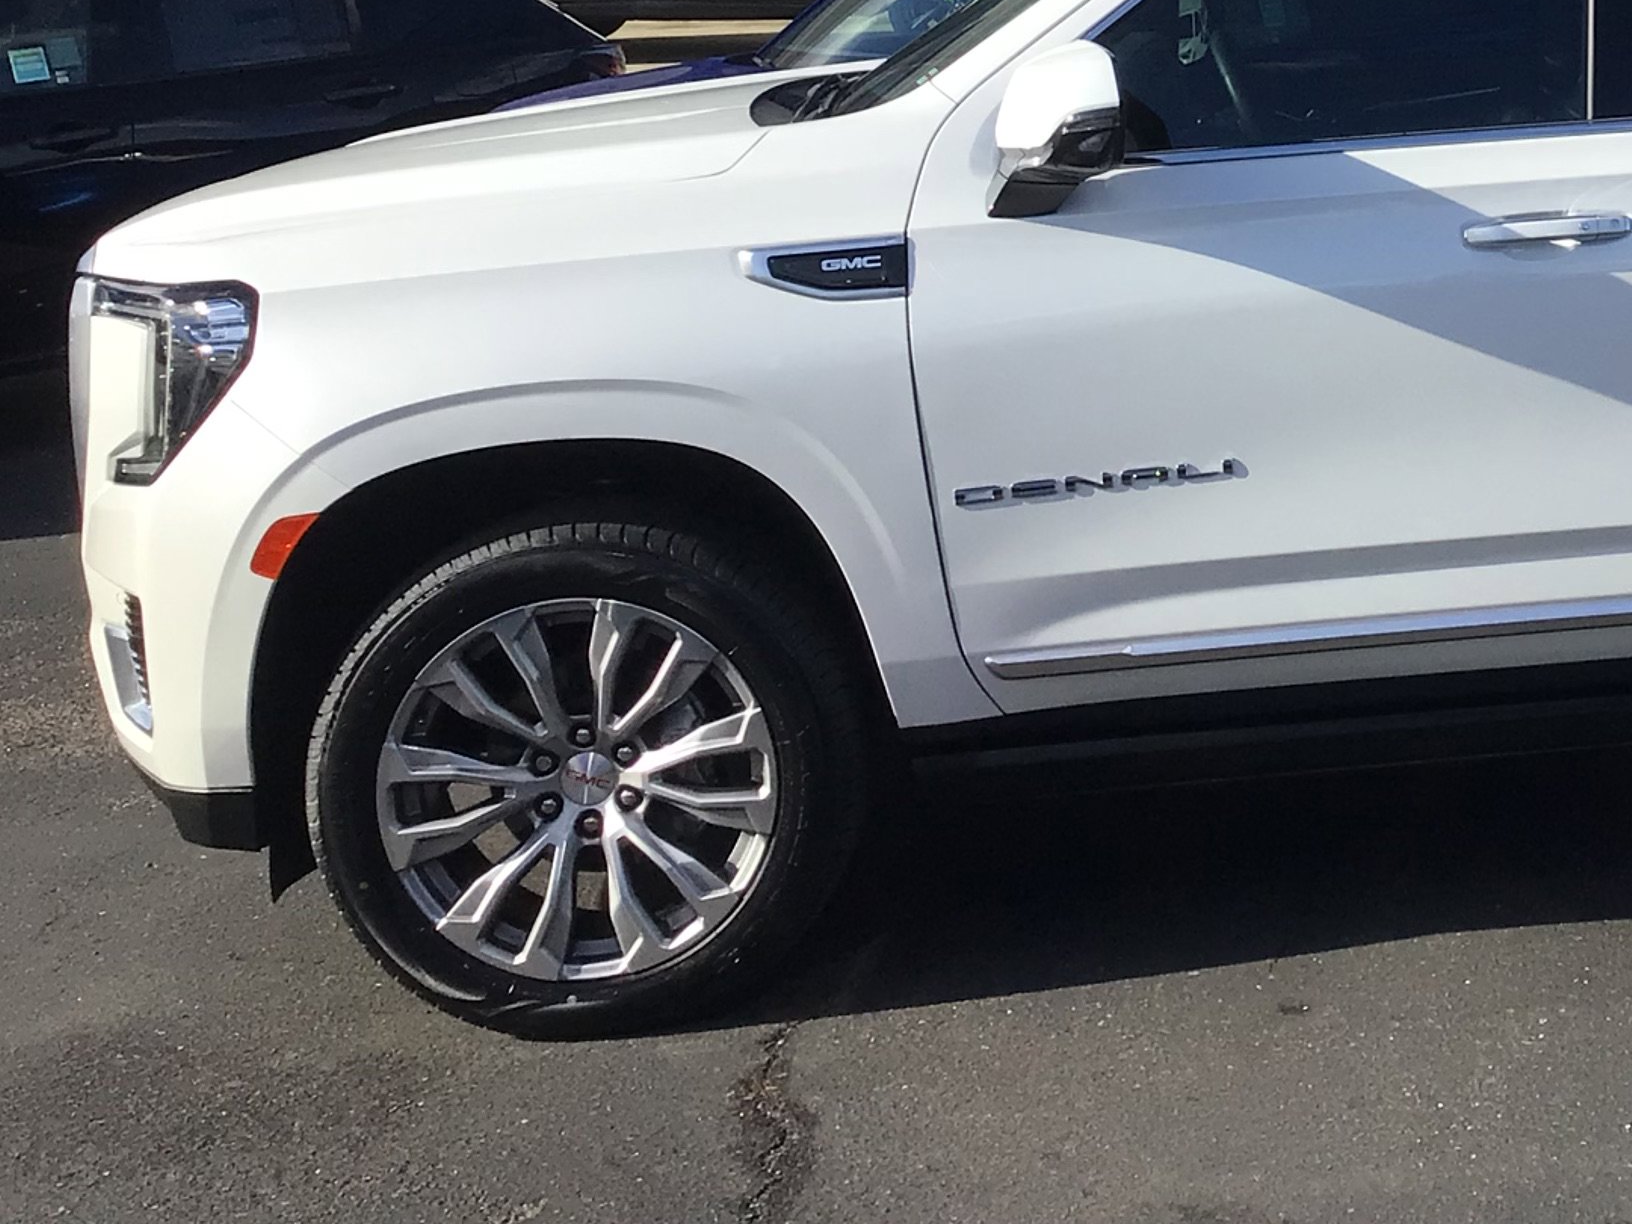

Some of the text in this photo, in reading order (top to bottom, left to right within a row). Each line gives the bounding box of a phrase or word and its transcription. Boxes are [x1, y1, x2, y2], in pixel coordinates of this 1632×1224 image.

[820, 254, 882, 272] GMC
[953, 458, 1234, 506] DENALI
[565, 769, 611, 790] GMC
